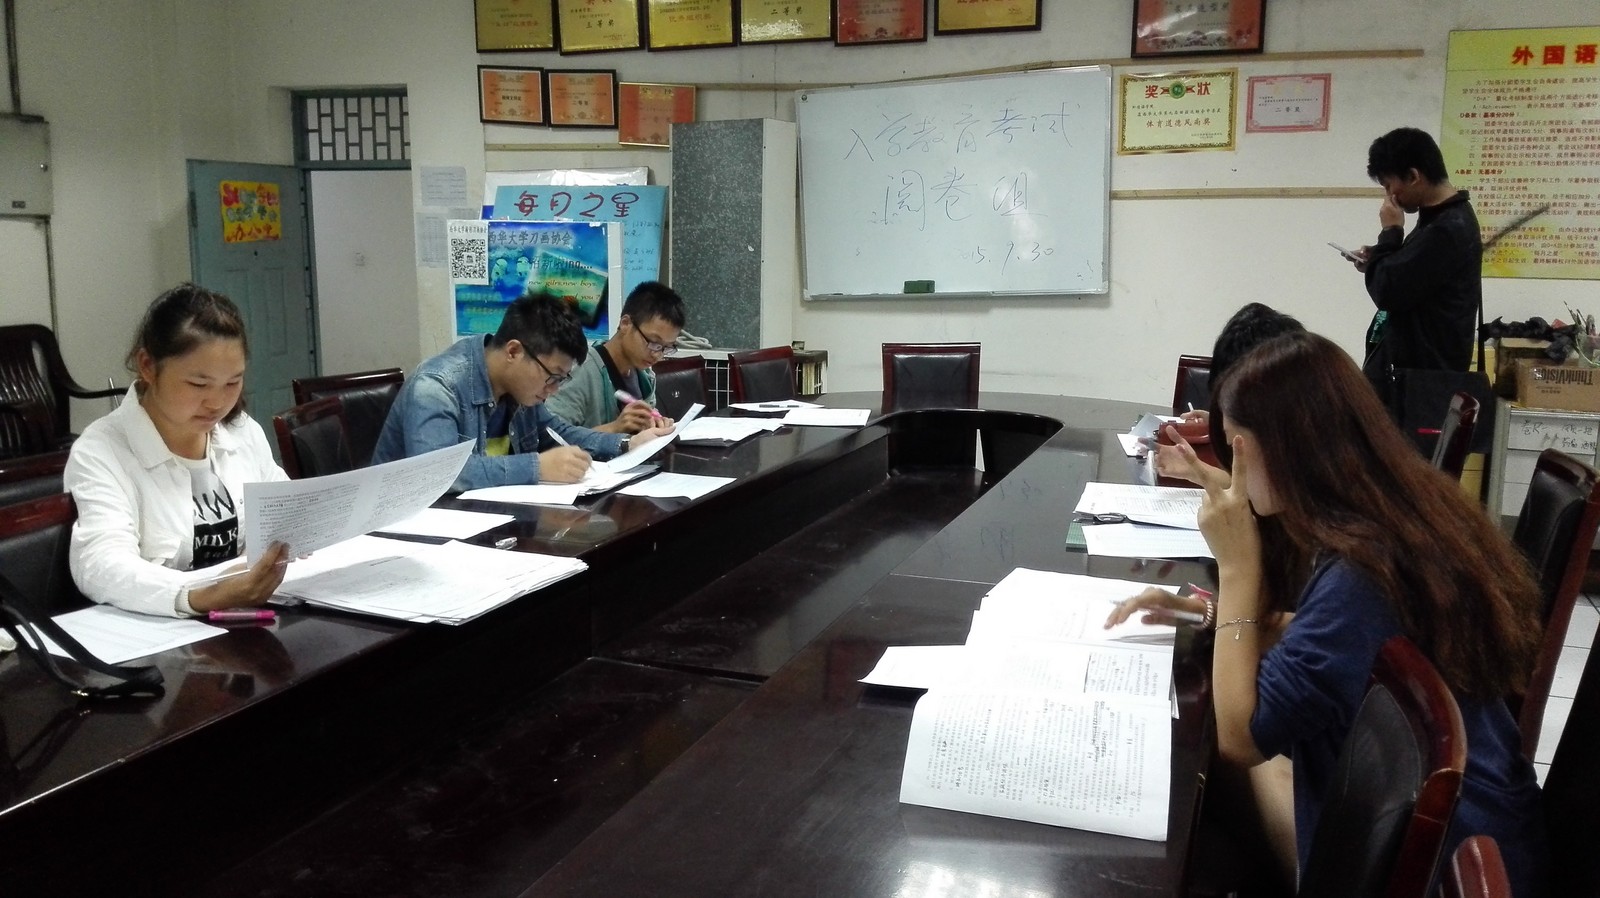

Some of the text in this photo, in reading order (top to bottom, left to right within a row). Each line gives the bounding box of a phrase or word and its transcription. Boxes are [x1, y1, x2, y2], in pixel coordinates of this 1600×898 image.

[769, 5, 803, 16] 二等奖
[1511, 43, 1598, 66] 外国语
[1145, 82, 1211, 98] 奖 状
[844, 101, 1074, 162] 入学教育考试
[1146, 117, 1212, 129] 体育道德风尚奖
[513, 190, 640, 218] 每月之星
[883, 166, 1048, 232] 阅卷组
[488, 230, 573, 246] 西华大学刀画协会
[193, 527, 238, 550] MILK
